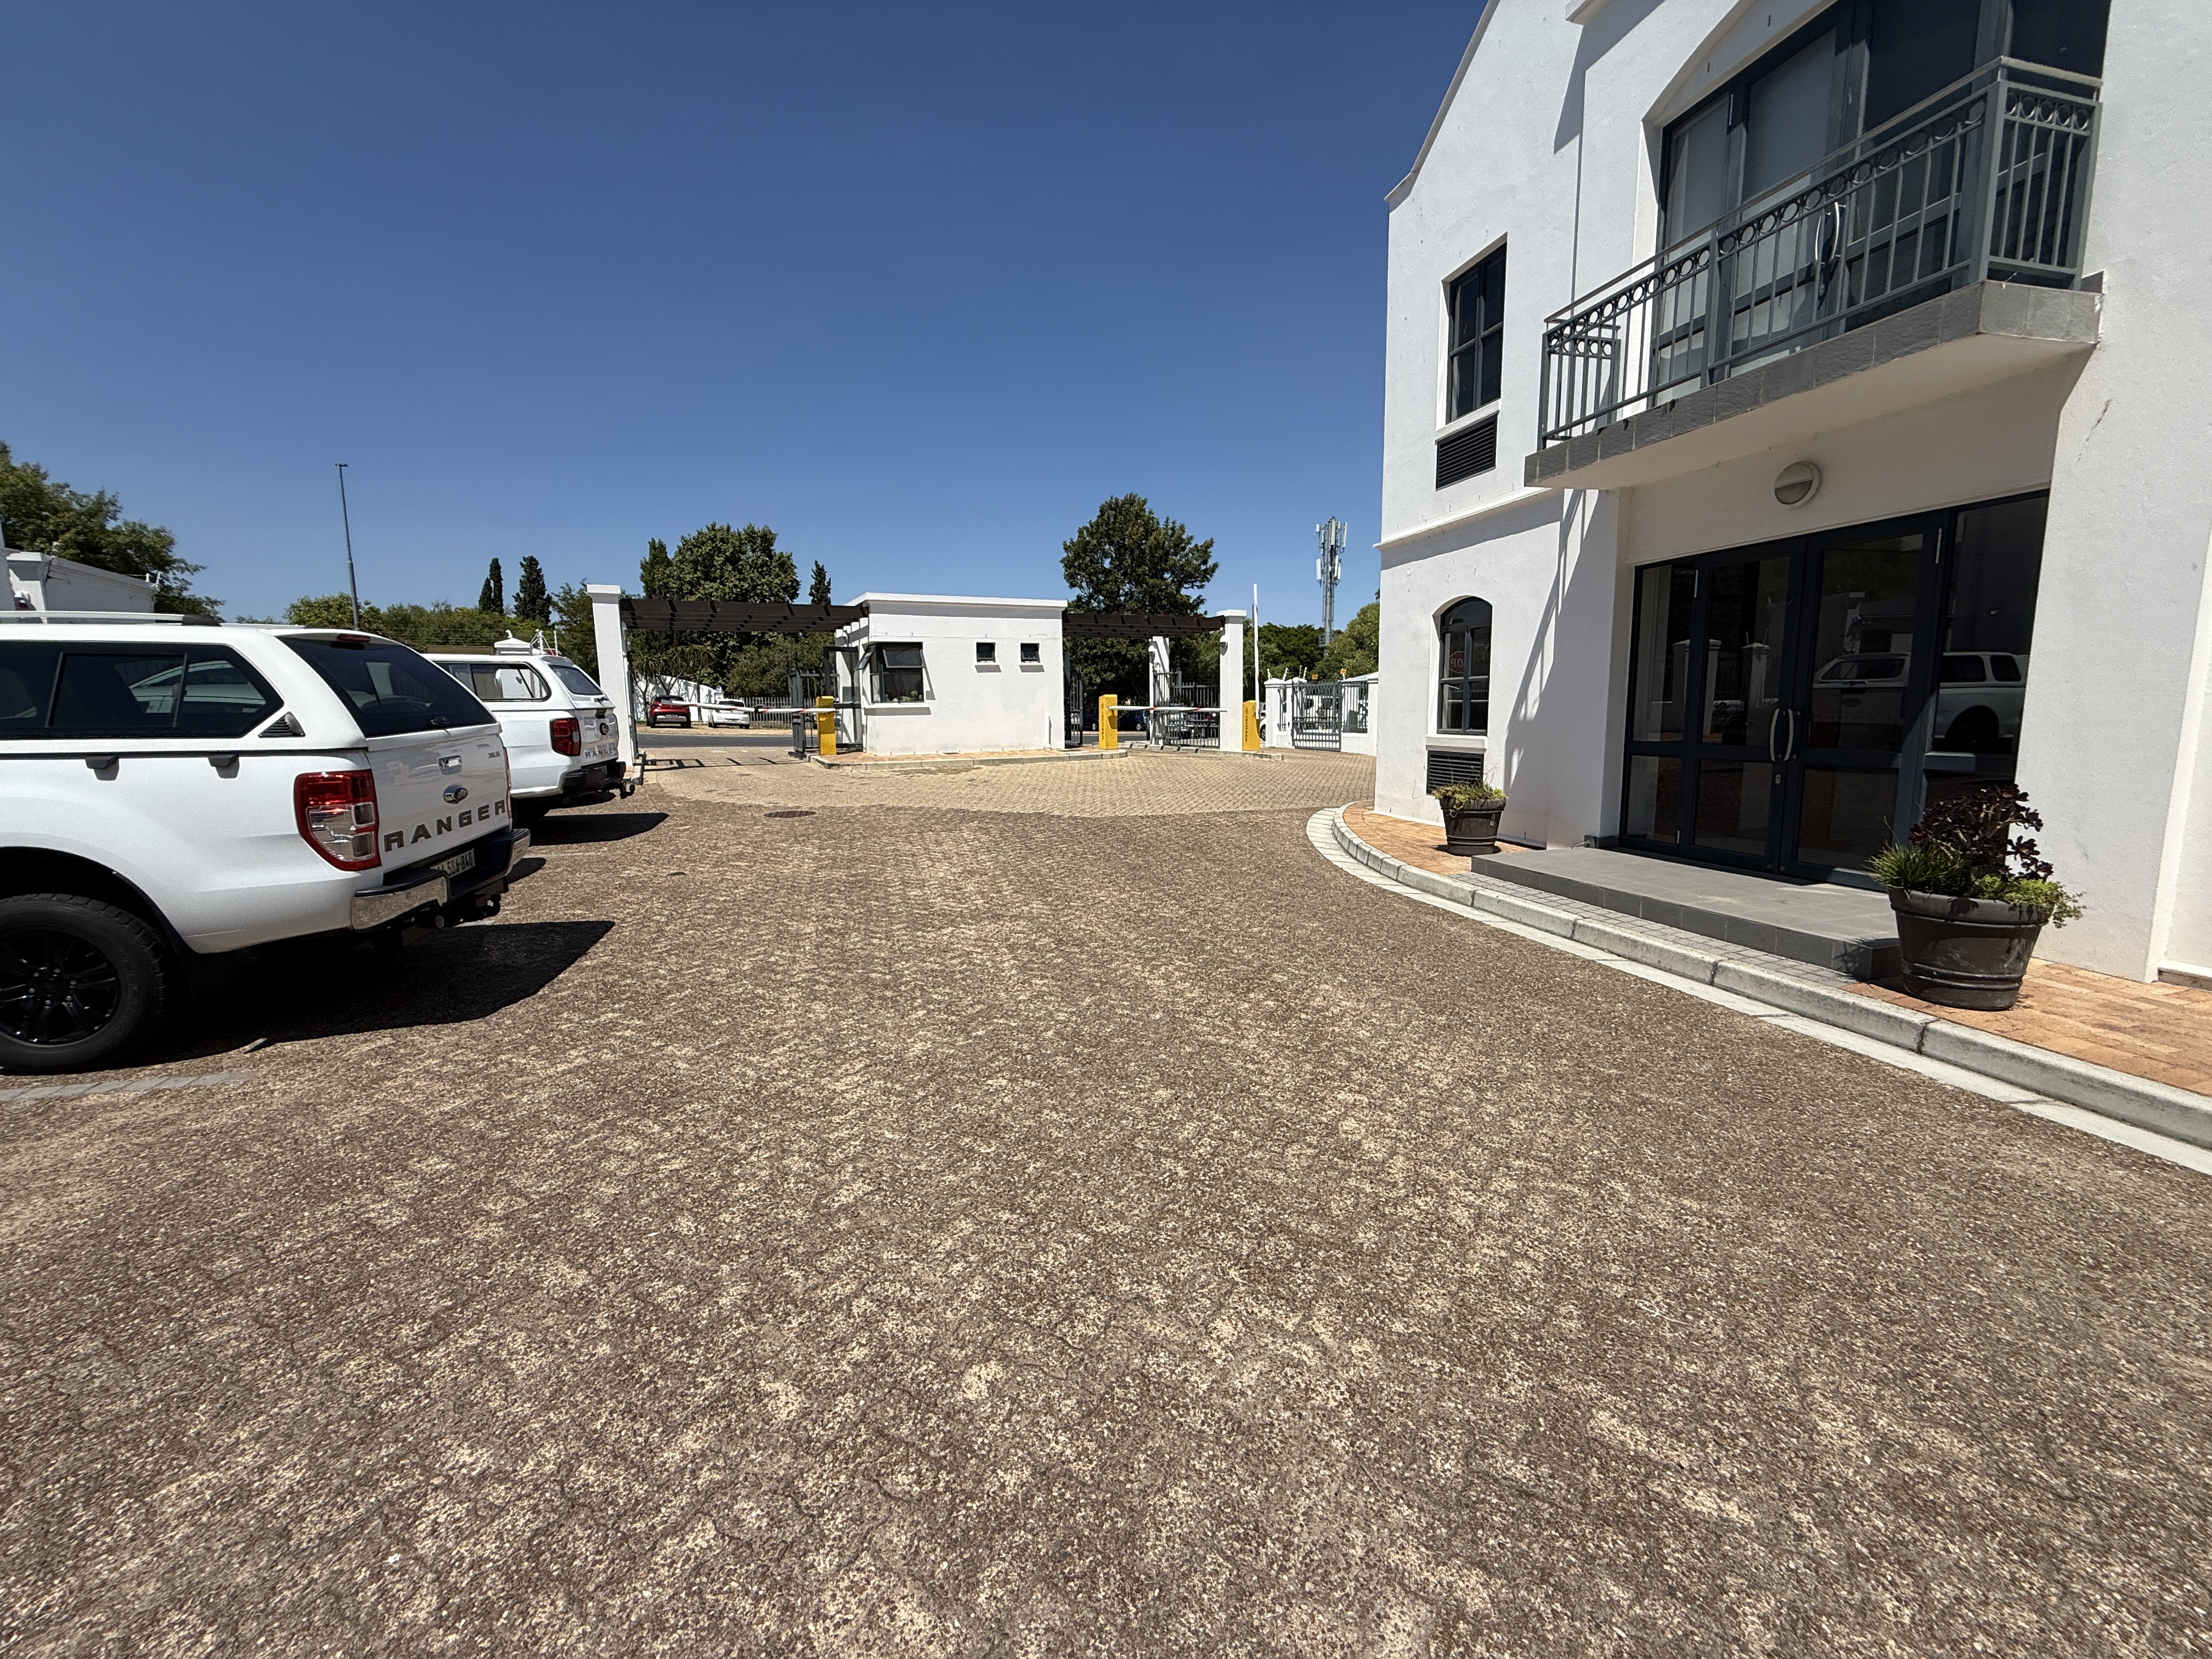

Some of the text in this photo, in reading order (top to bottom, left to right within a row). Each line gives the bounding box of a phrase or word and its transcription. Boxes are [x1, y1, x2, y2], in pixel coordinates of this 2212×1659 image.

[488, 751, 500, 759] XLS
[585, 747, 617, 759] RANGER
[384, 799, 506, 852] RANGER
